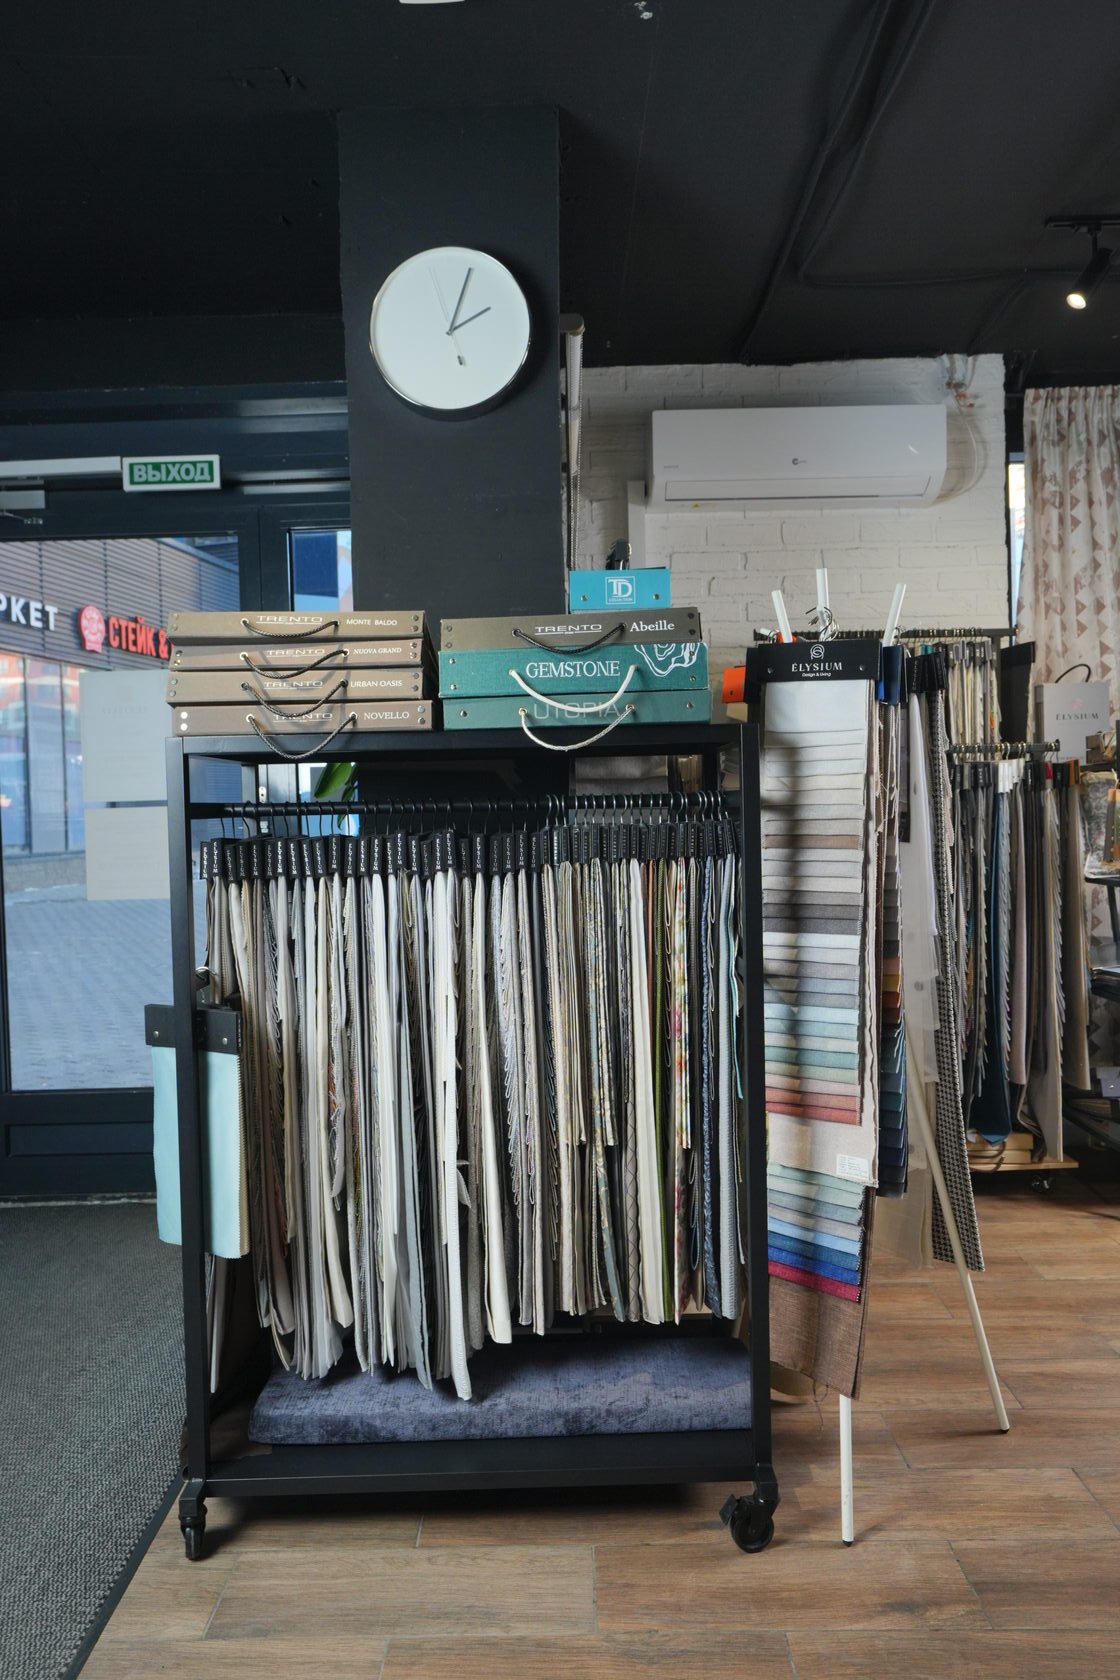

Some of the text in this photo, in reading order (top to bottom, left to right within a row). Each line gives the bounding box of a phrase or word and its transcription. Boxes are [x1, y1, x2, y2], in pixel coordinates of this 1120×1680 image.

[133, 462, 211, 483] ВЫХОД
[608, 579, 633, 598] TD
[257, 615, 323, 623] TRENTO
[346, 618, 371, 626] MONTE
[535, 620, 675, 633] TRENTO Abeille
[108, 614, 169, 659] СТЕЙК &
[266, 648, 325, 656] TRENTO
[525, 661, 620, 678] GEMSTONE
[264, 679, 403, 688] TRENTO URBAN OASIS
[363, 711, 410, 721] NOVELLO
